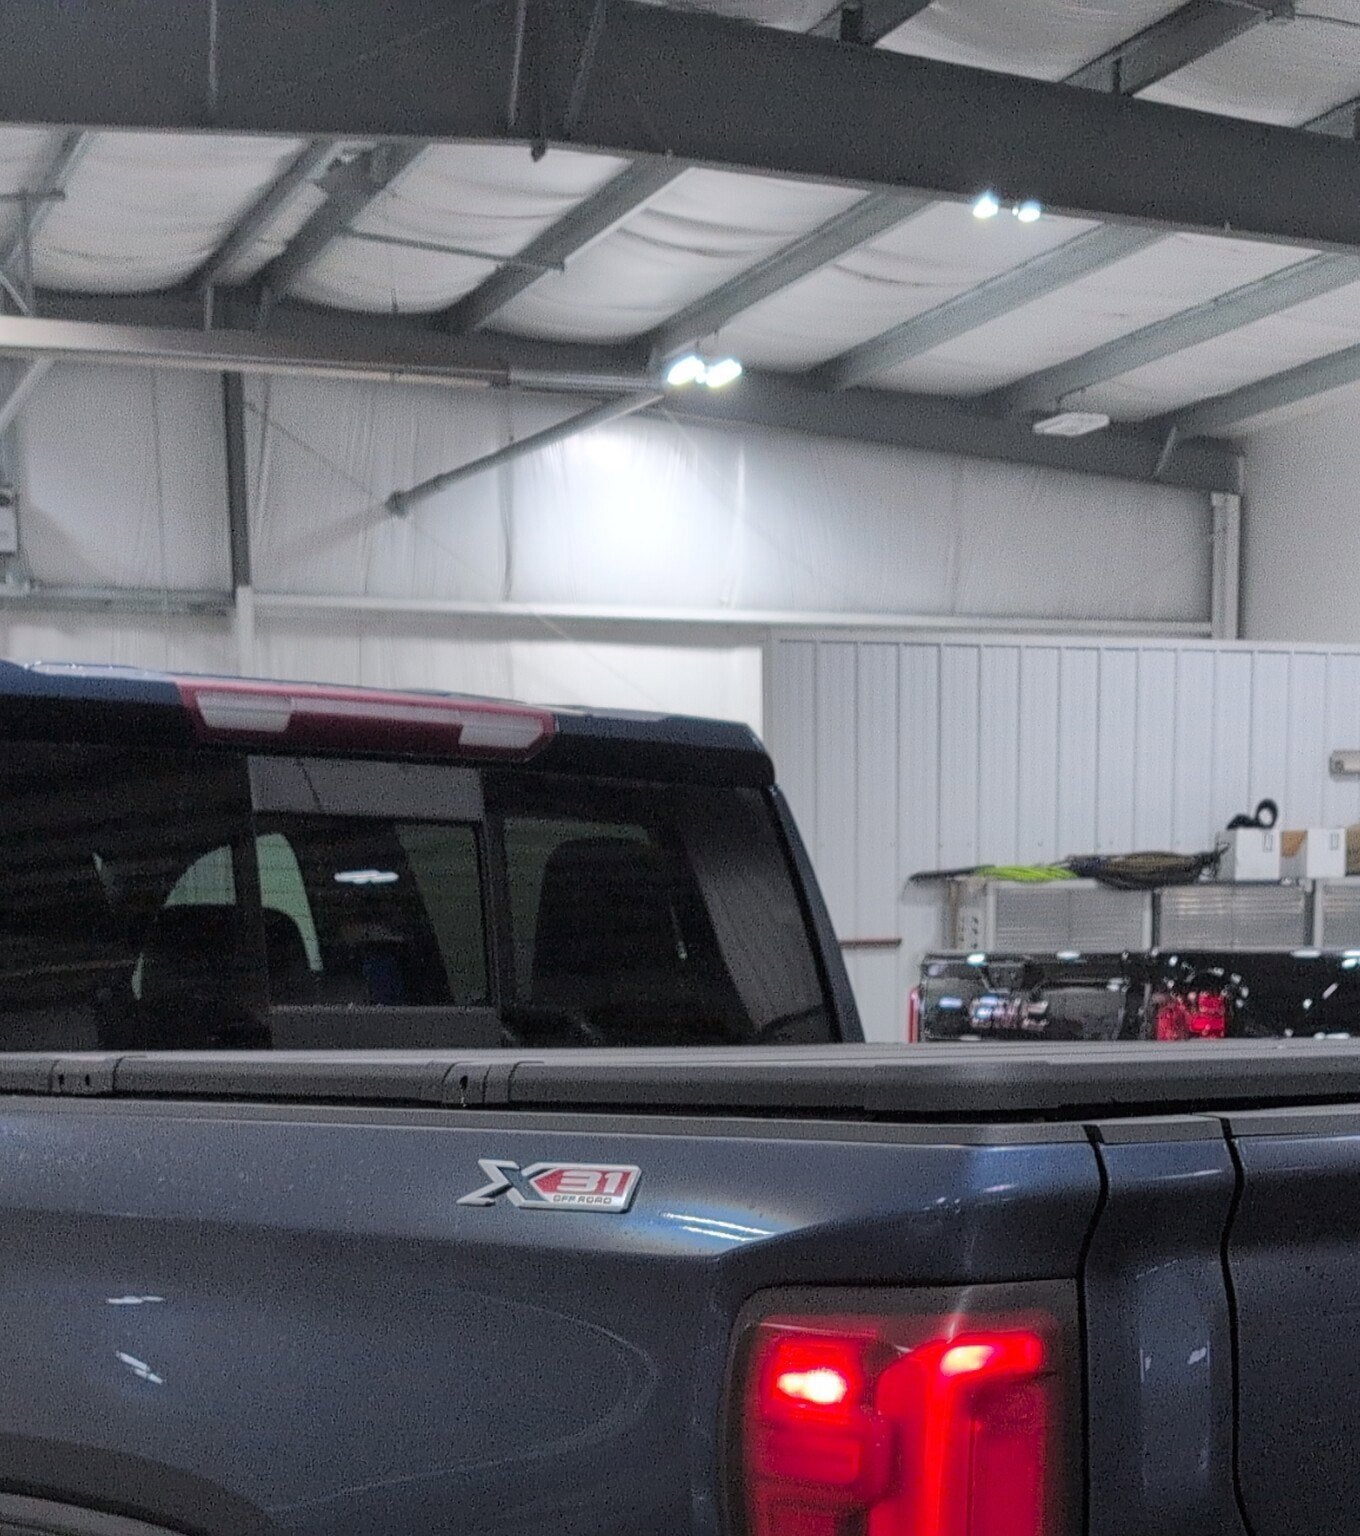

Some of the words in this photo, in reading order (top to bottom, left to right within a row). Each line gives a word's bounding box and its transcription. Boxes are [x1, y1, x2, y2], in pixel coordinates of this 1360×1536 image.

[456, 1158, 641, 1214] X31
[552, 1194, 576, 1204] OFF
[577, 1194, 612, 1205] ROAD
